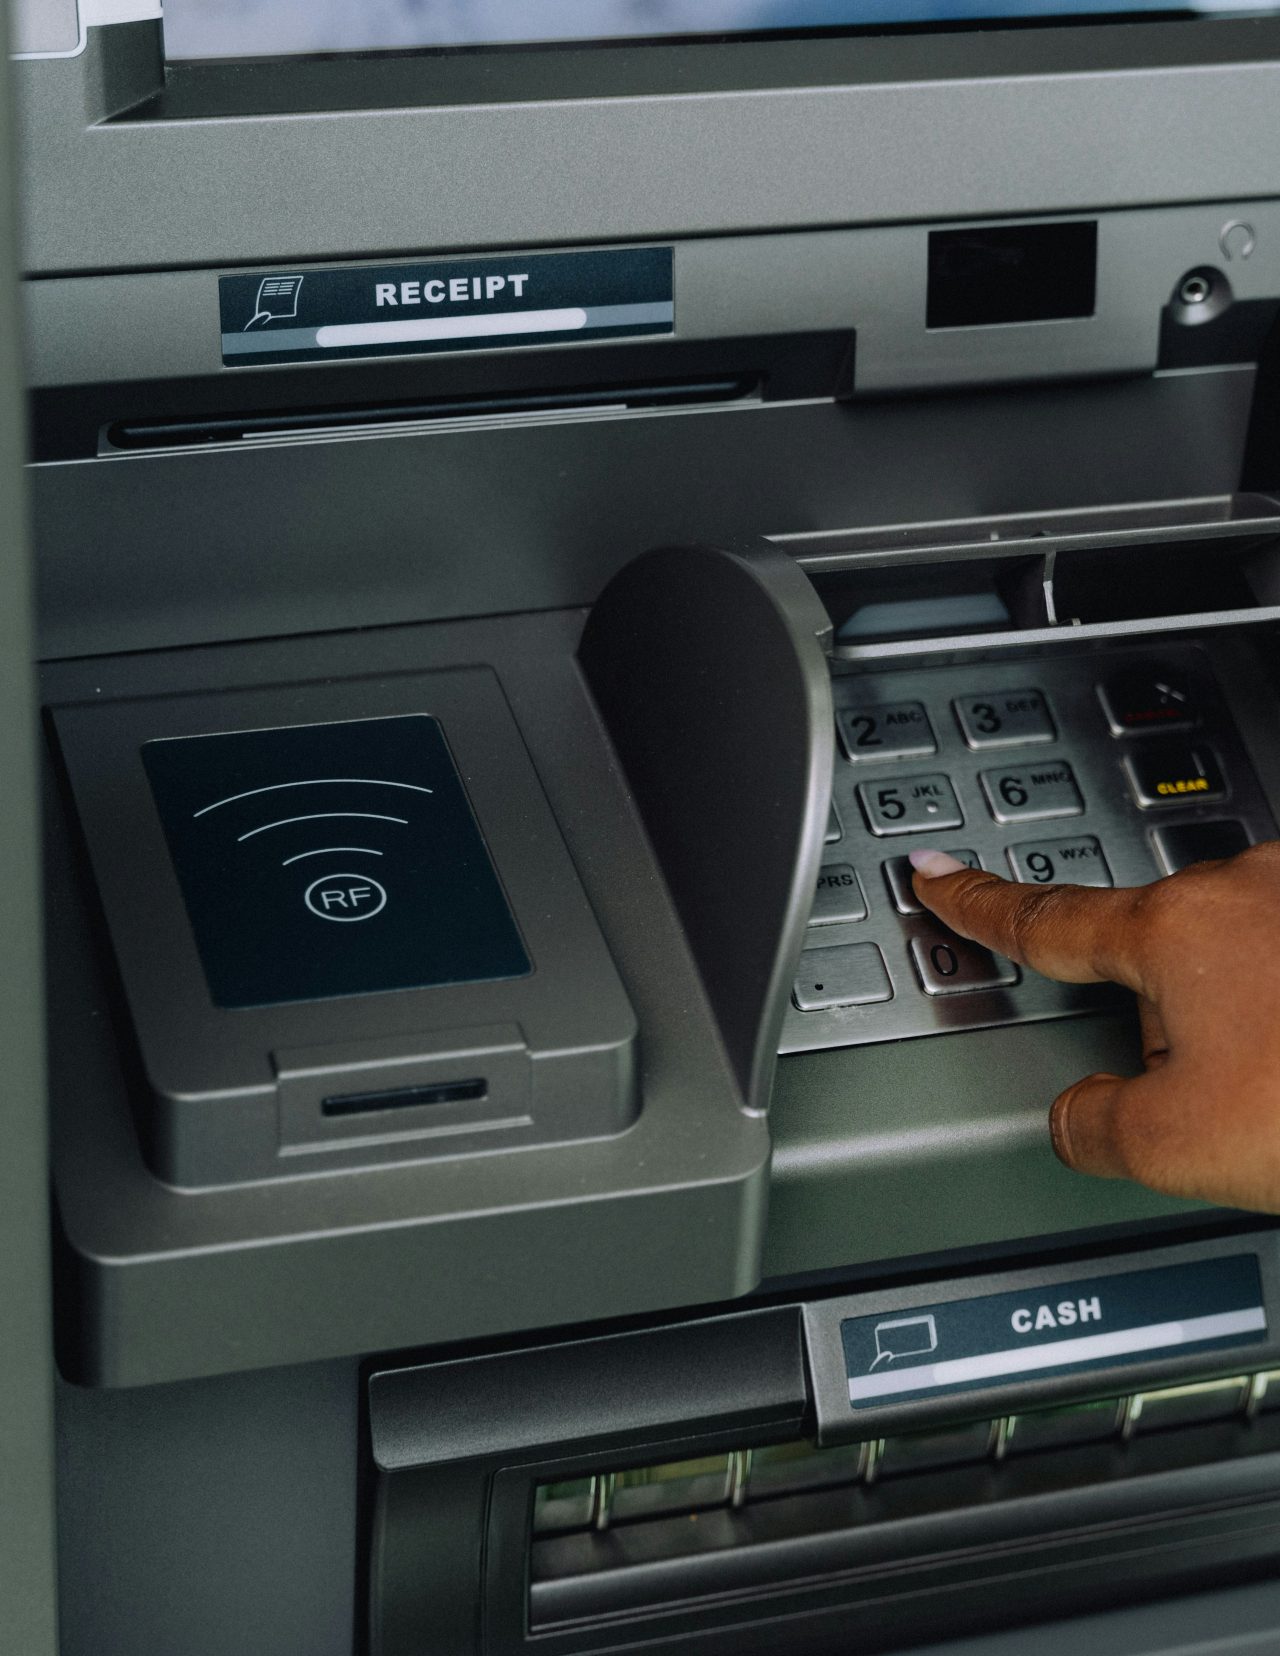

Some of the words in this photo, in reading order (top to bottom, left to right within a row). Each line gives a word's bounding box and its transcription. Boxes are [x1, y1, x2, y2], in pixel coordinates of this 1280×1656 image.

[375, 273, 529, 306] RECEIPT
[851, 716, 883, 746] 2
[886, 711, 922, 725] ABC
[972, 703, 1002, 733] 3
[1006, 700, 1041, 713] DEF
[877, 788, 905, 819] 5
[912, 785, 944, 798] JKL
[999, 776, 1028, 807] 6
[1156, 777, 1209, 795] CLEAR
[1026, 853, 1054, 883] 9
[321, 887, 371, 910] RF
[930, 944, 958, 976] 0
[1011, 1297, 1101, 1333] CASH
